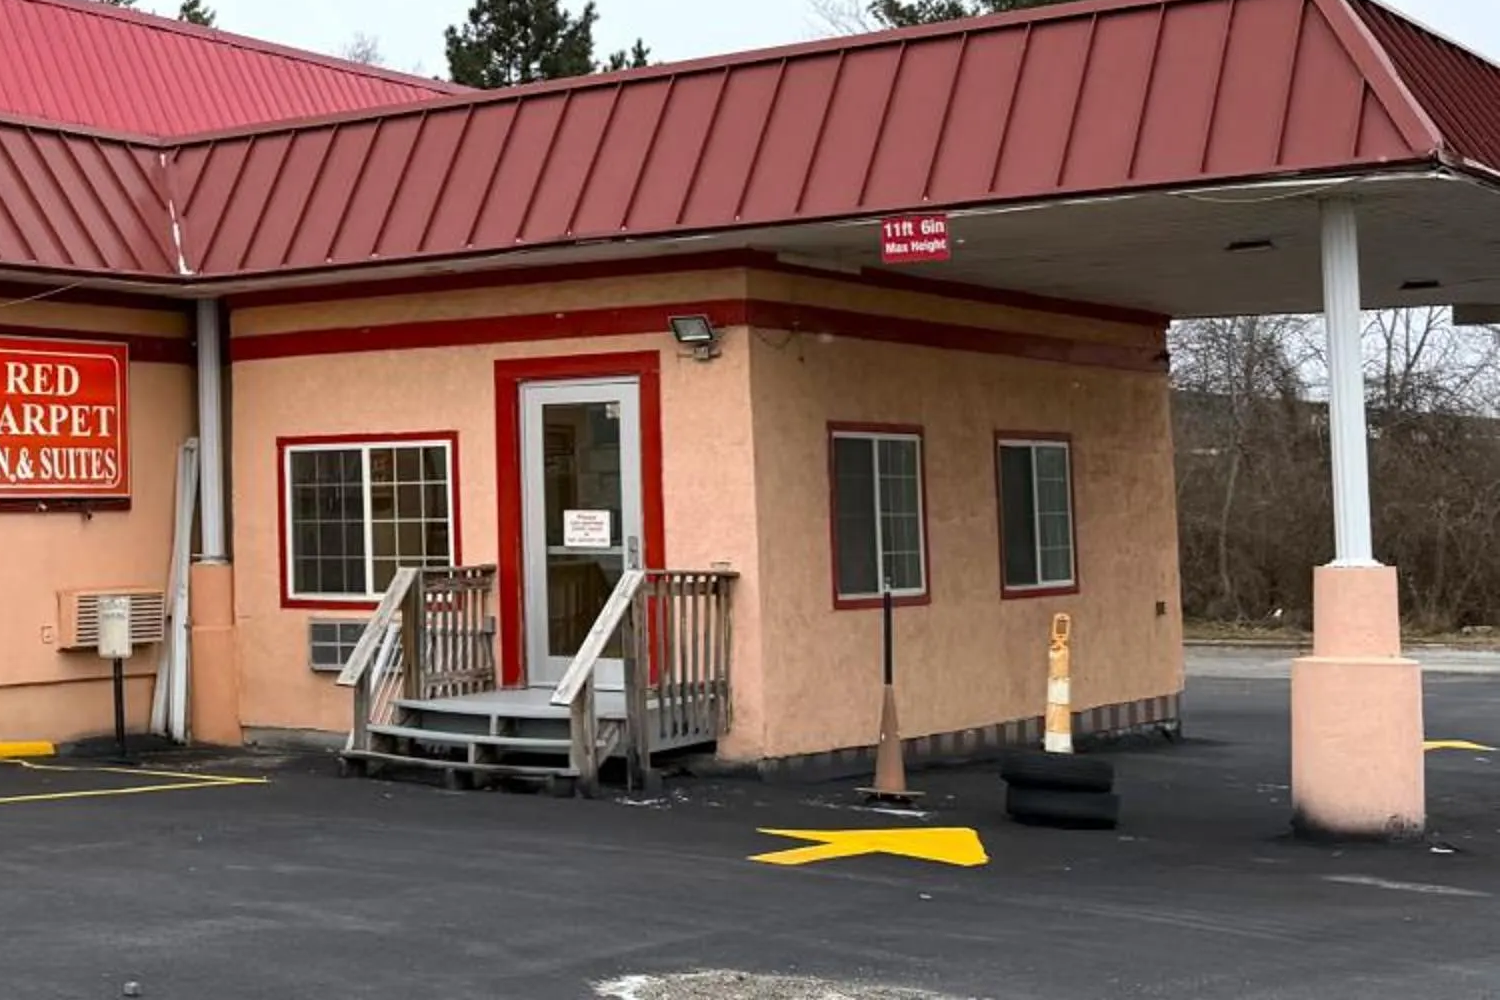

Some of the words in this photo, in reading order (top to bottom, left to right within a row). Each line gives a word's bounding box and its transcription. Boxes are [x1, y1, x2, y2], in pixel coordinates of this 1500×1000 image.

[883, 221, 914, 237] 11ft
[885, 242, 909, 254] Max
[910, 239, 947, 253] Height
[4, 361, 80, 396] RED
[16, 446, 35, 480] &
[39, 446, 117, 480] SUITES
